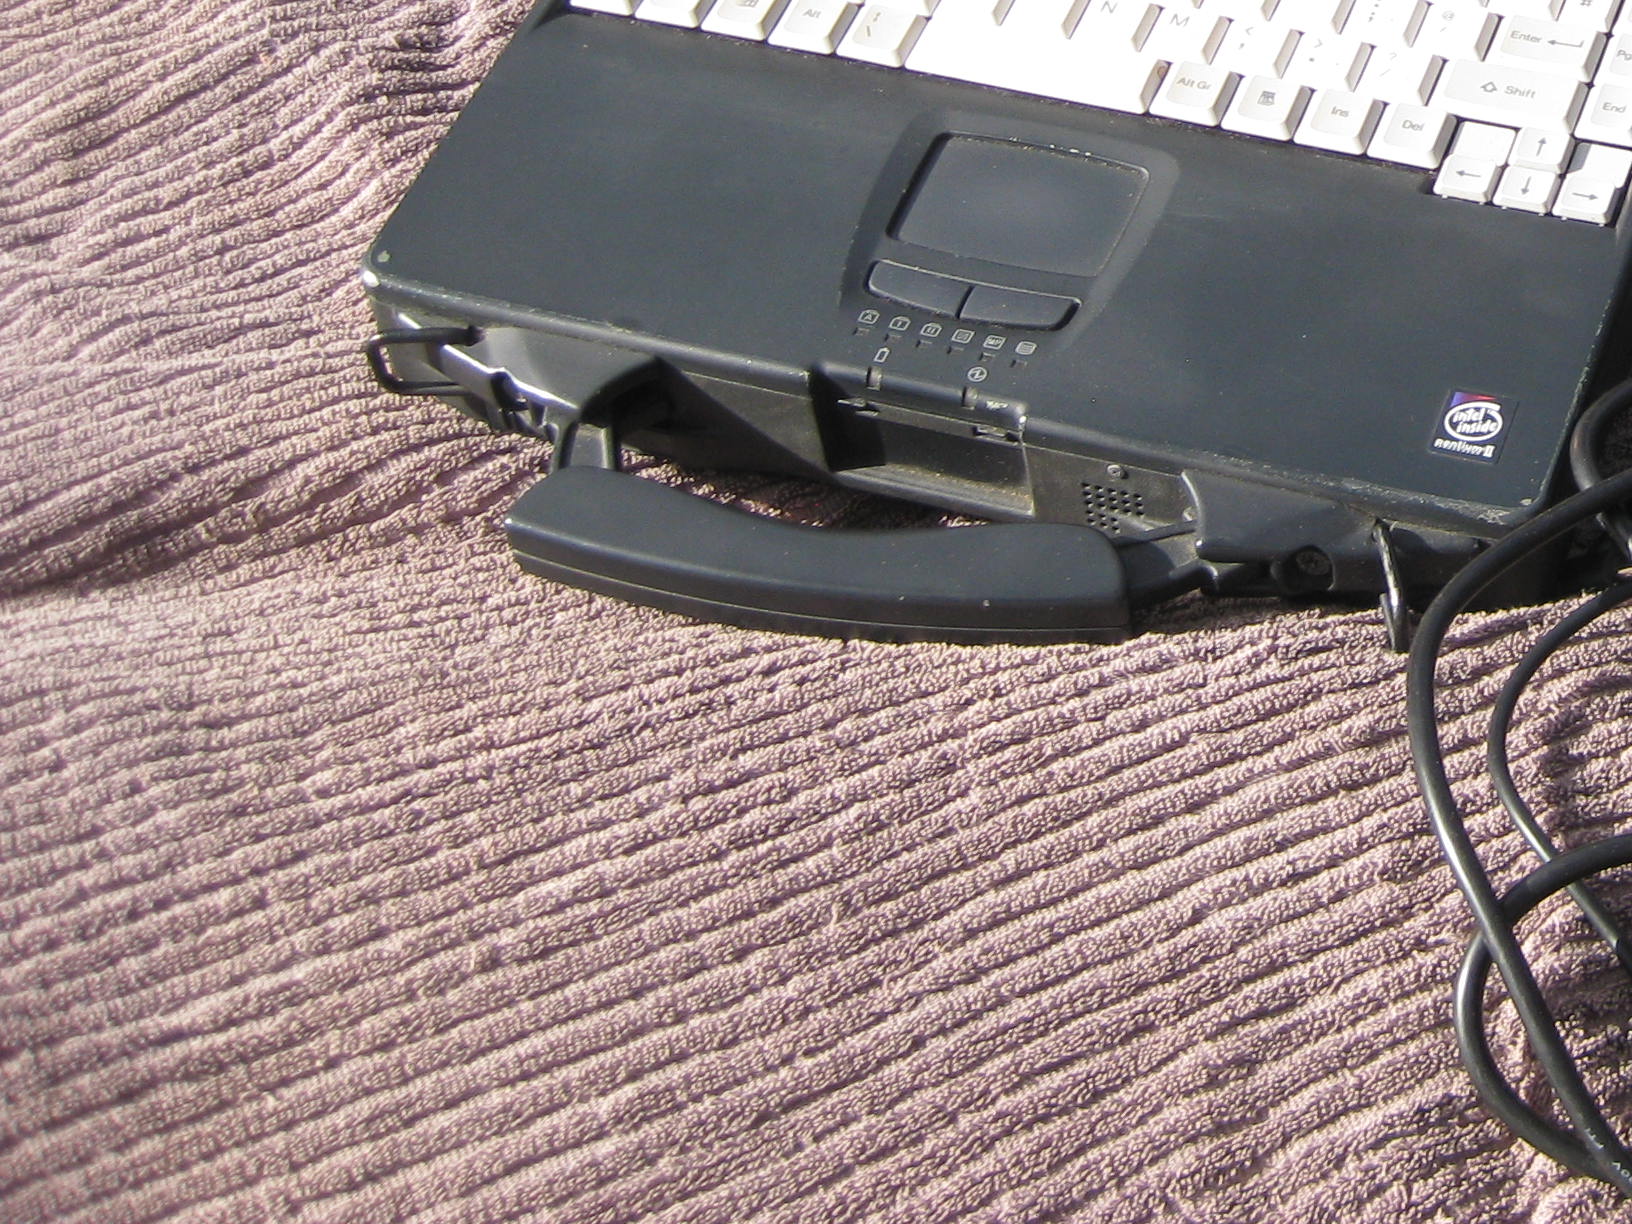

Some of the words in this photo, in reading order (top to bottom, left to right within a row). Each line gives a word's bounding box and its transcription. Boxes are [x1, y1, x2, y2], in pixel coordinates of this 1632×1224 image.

[803, 7, 821, 19] Alt
[1100, 0, 1118, 14] N
[1169, 13, 1190, 27] M
[1509, 29, 1544, 44] Enter
[1503, 84, 1537, 100] Shift
[1330, 105, 1350, 118] Ins
[1602, 101, 1627, 114] End
[1401, 119, 1425, 133] Del
[1452, 407, 1486, 423] intel
[1456, 419, 1499, 434] inside
